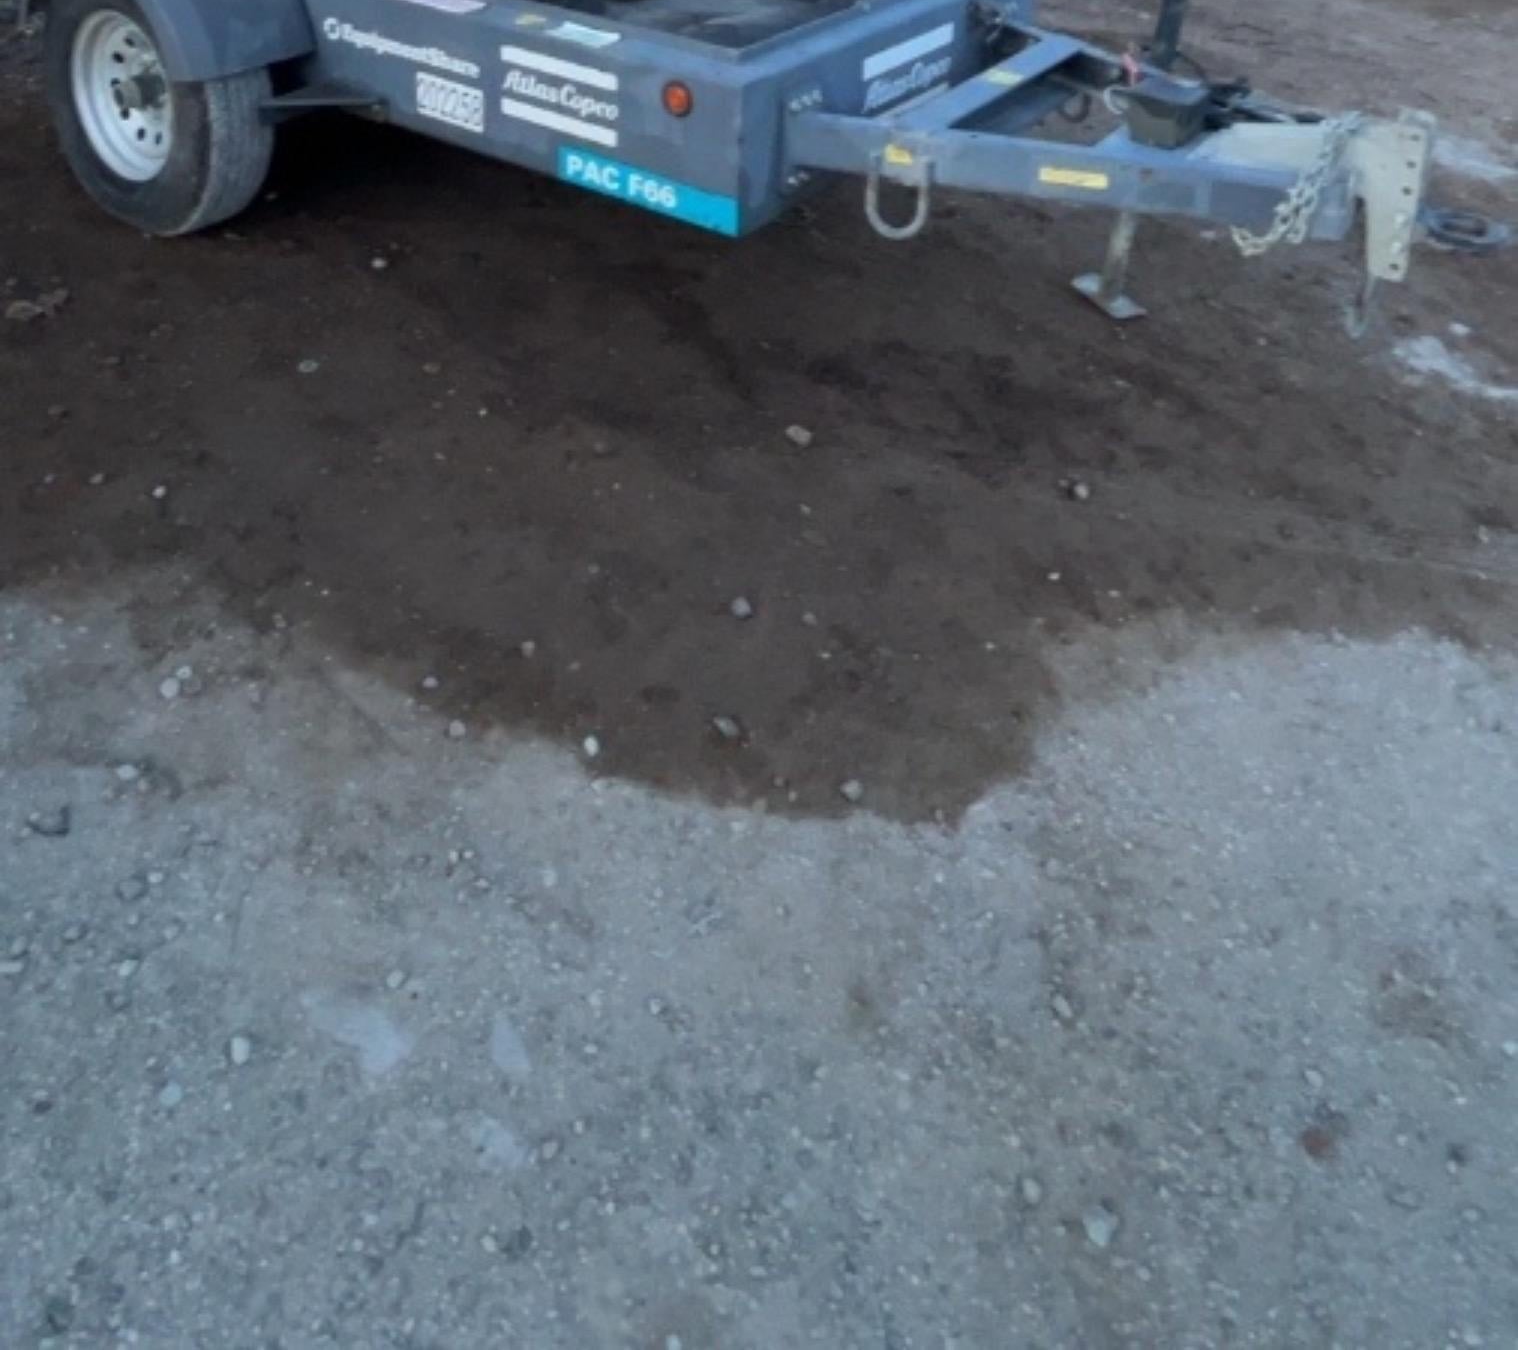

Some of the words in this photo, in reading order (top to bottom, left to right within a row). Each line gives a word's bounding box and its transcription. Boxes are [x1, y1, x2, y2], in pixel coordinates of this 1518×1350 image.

[341, 23, 481, 79] EquipmentShare
[566, 154, 620, 191] PAC
[628, 173, 677, 208] F66
